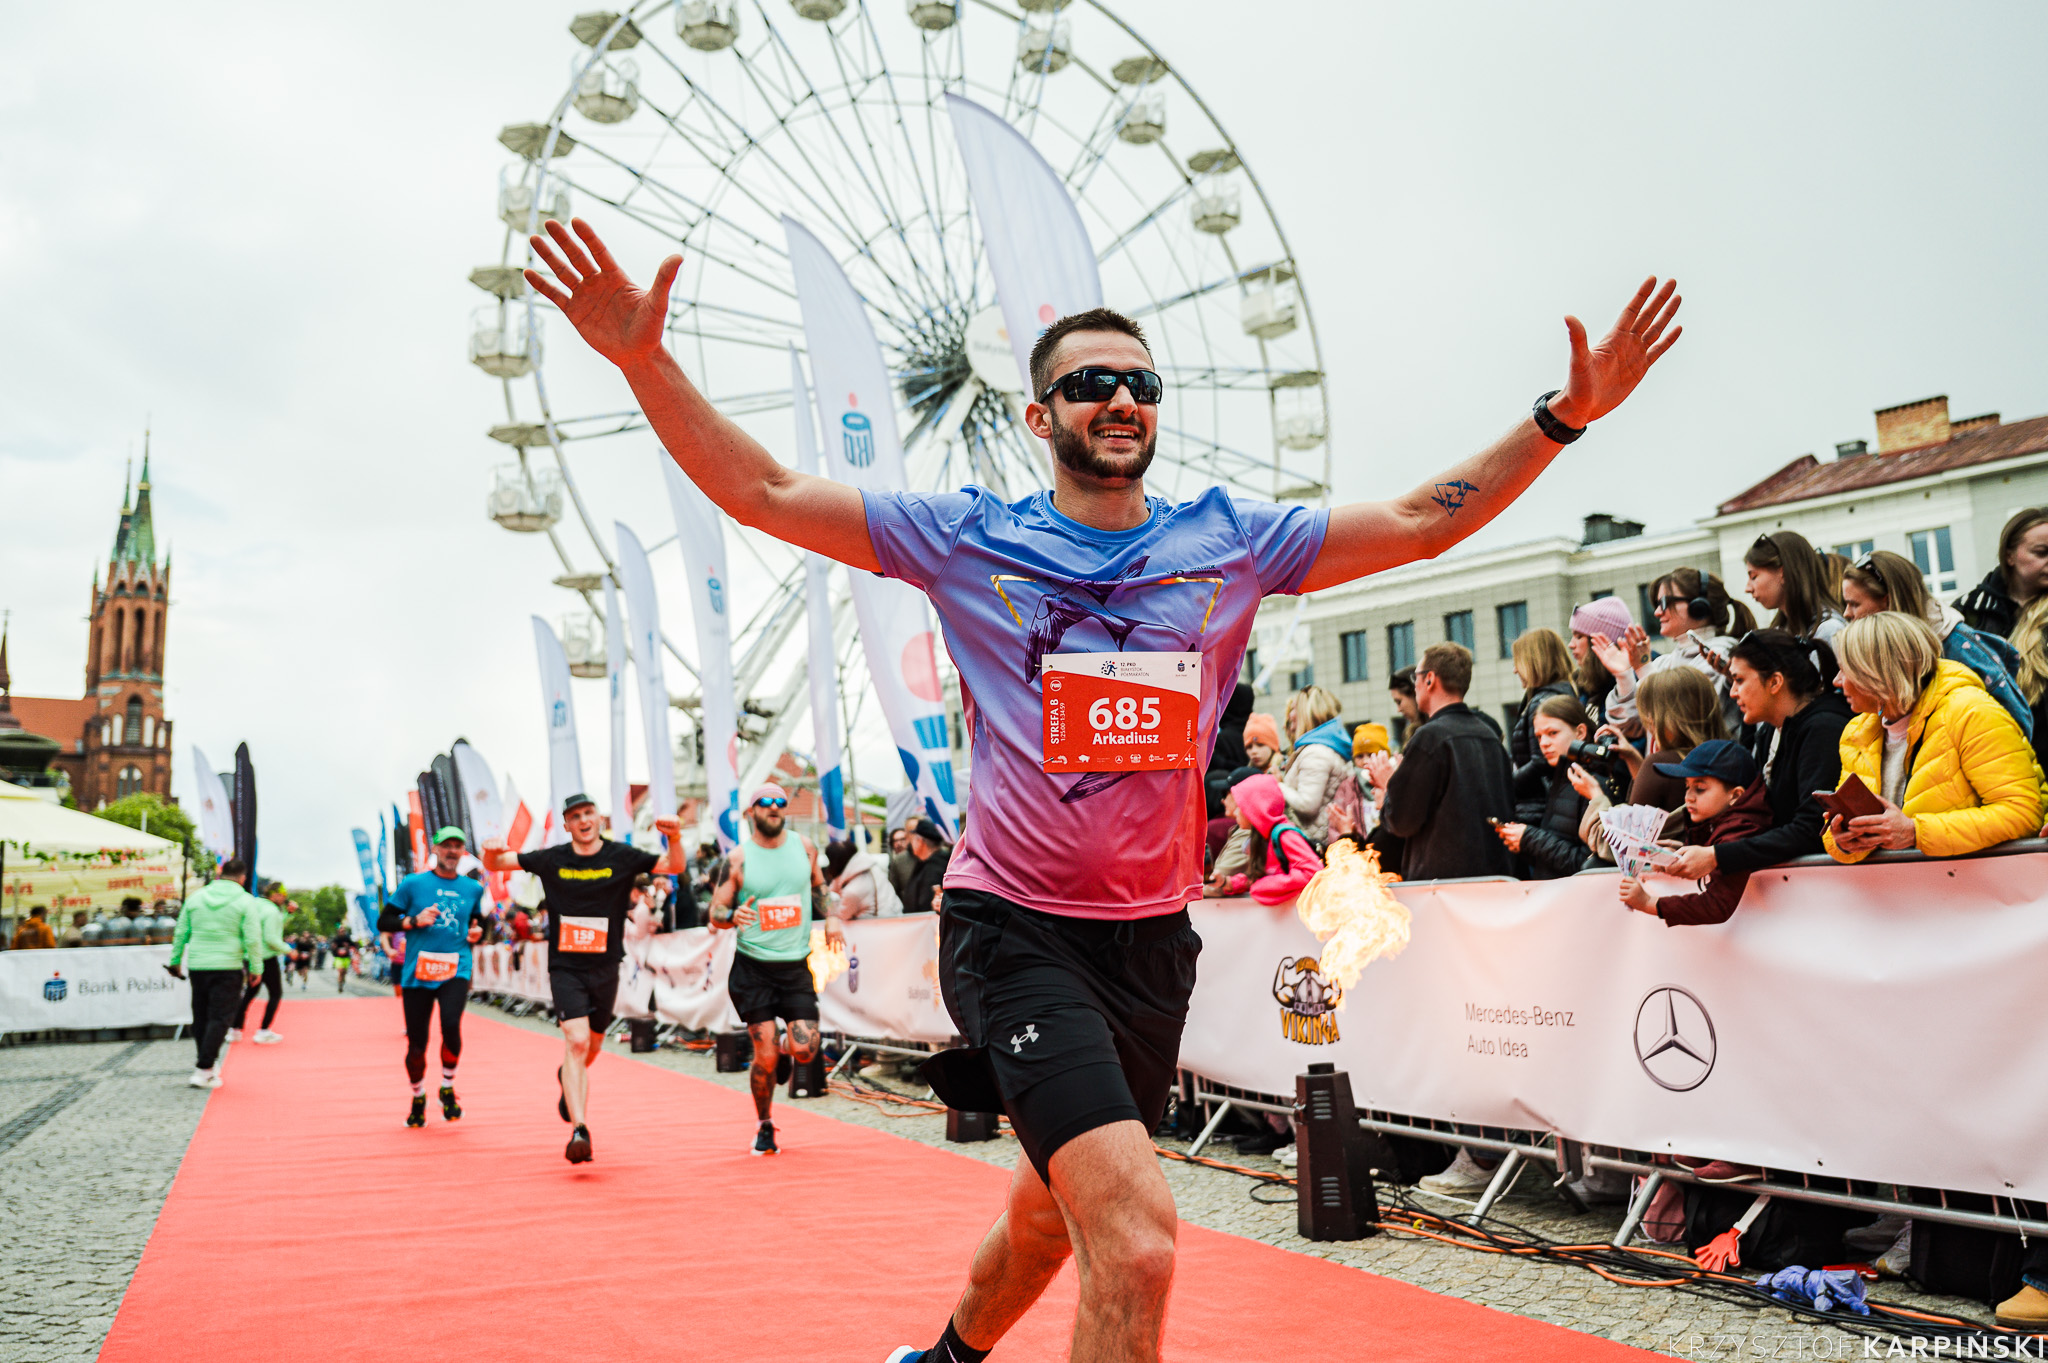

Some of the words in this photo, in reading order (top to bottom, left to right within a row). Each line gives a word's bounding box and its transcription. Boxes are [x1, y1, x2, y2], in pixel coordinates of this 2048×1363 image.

[1050, 698, 1059, 706] B
[1088, 696, 1162, 731] 685
[1050, 708, 1060, 745] STREFA
[1092, 732, 1160, 745] Arkadiusz
[572, 929, 596, 941] 158
[78, 978, 120, 995] Bank
[126, 976, 175, 993] Polski
[1280, 1007, 1340, 1046] VIKINGA
[1464, 1001, 1576, 1027] Mercedes-Benz
[1467, 1033, 1496, 1055] Auto
[1498, 1036, 1529, 1058] Idea
